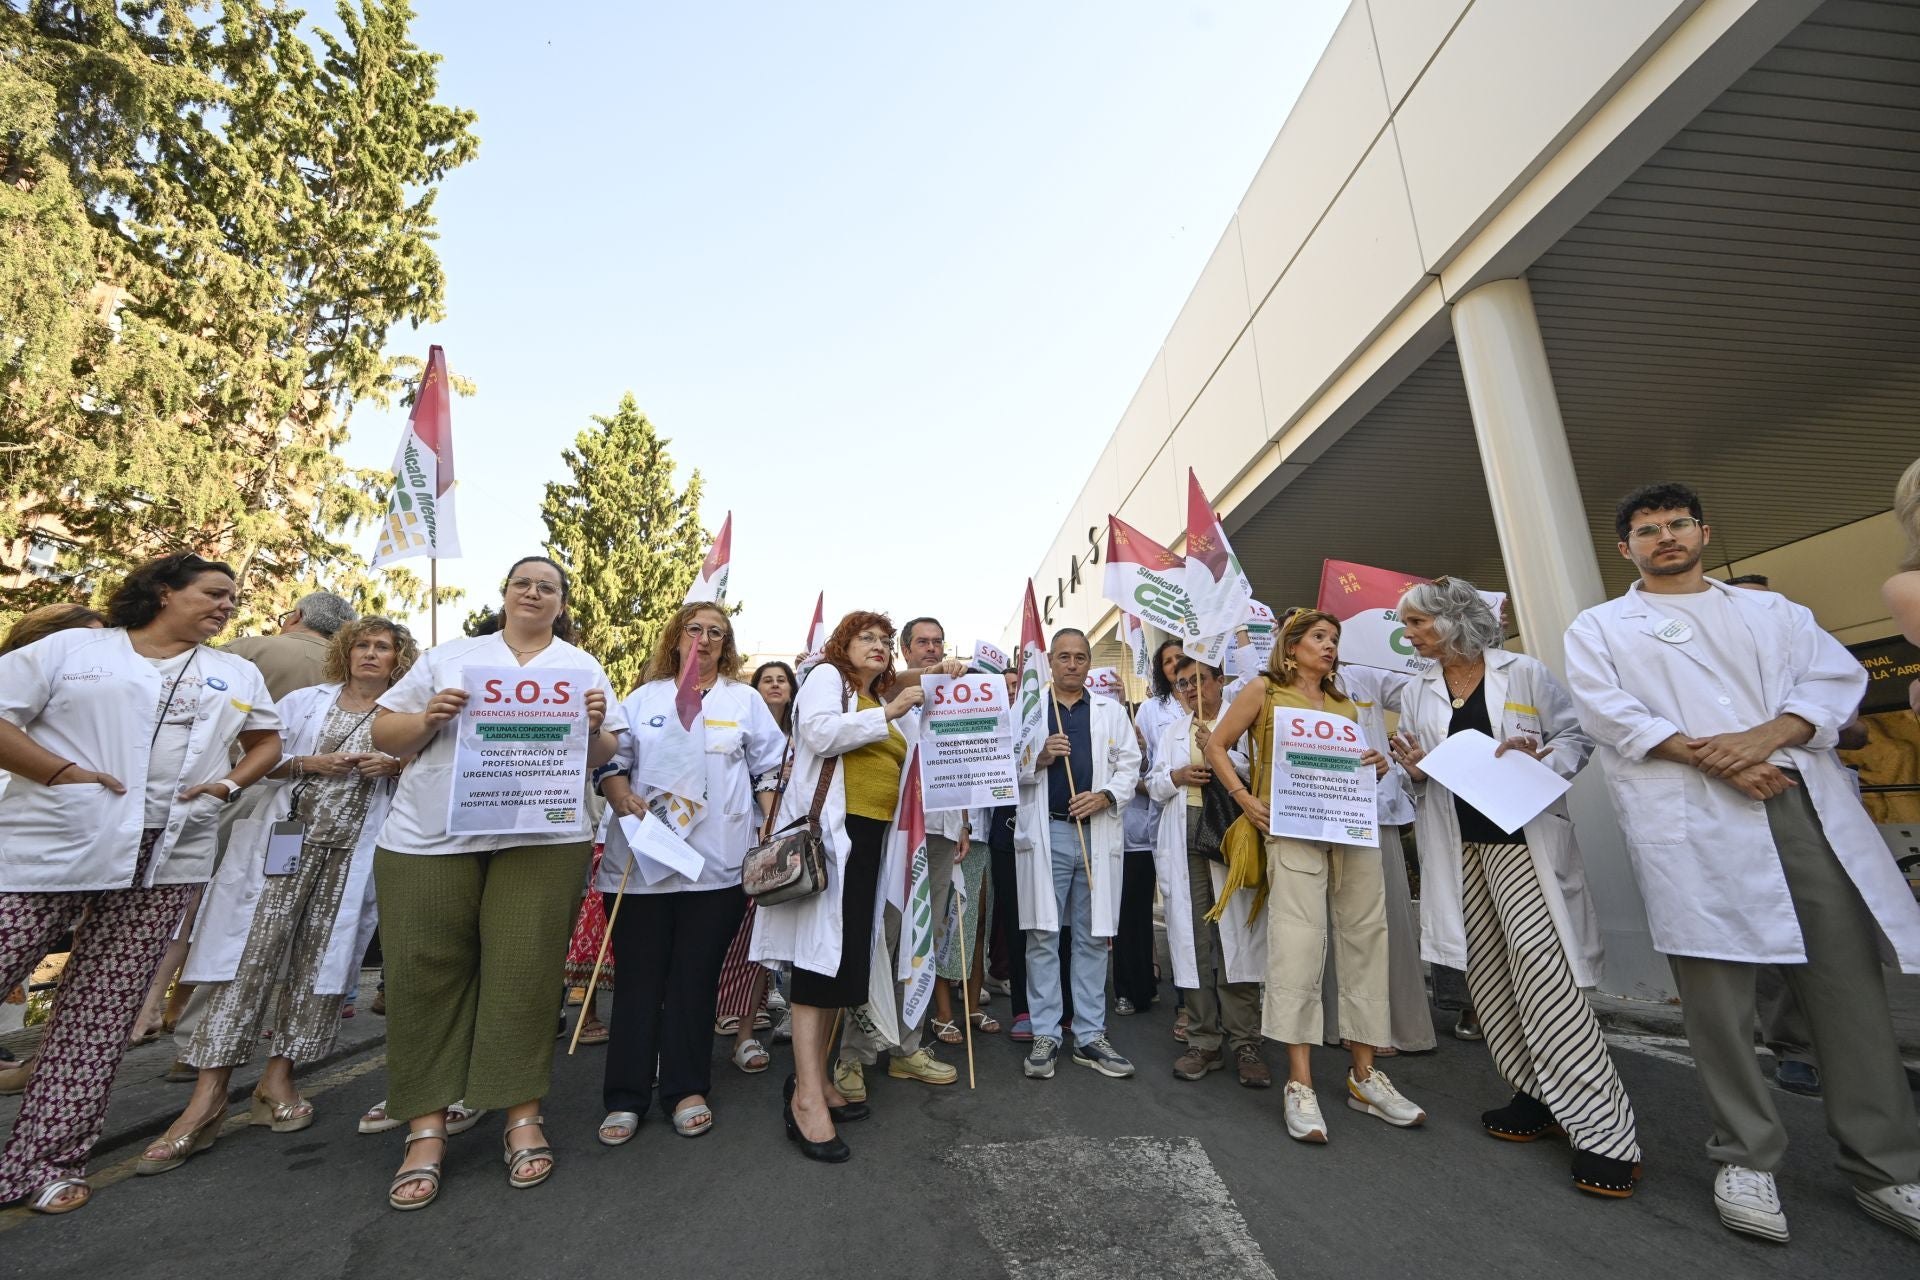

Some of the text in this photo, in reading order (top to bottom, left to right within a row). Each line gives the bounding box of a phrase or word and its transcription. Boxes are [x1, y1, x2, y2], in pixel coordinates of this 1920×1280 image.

[1136, 566, 1183, 595] Sindicato
[1140, 609, 1168, 627] Región
[1168, 622, 1179, 632] de
[981, 645, 1003, 664] S.O.S
[1872, 670, 1890, 680] LA
[484, 679, 571, 705] S.O.S
[934, 683, 993, 705] S.O.S
[957, 706, 1002, 715] HOSPITALARIAS
[1291, 718, 1357, 743] S.O.S
[936, 738, 989, 748] CONCENTRACIÓN
[1281, 741, 1316, 749] URGENCIAS
[480, 749, 555, 757] CONCENTRACIÓN
[939, 747, 988, 756] PROFESIONALES
[482, 759, 551, 767] PROFESIONALES
[926, 754, 1011, 766] URGENCIAS HOSPITALARIAS
[1293, 761, 1328, 769] LABORALES
[1318, 756, 1358, 765] CONDICIONES
[463, 769, 580, 778] URGENCIAS HOSPITALARIAS
[984, 777, 1013, 785] MESEGUER
[1290, 773, 1349, 785] CONCENTRACIÓN
[1292, 781, 1347, 793] PROFESIONALES
[521, 789, 542, 798] JULIO
[1278, 789, 1372, 804] URGENCIAS HOSPITALARIAS
[460, 800, 499, 808] HOSPITAL
[1324, 808, 1342, 816] JULIO
[1309, 814, 1338, 822] MORALES
[1339, 818, 1372, 826] MESEGUER
